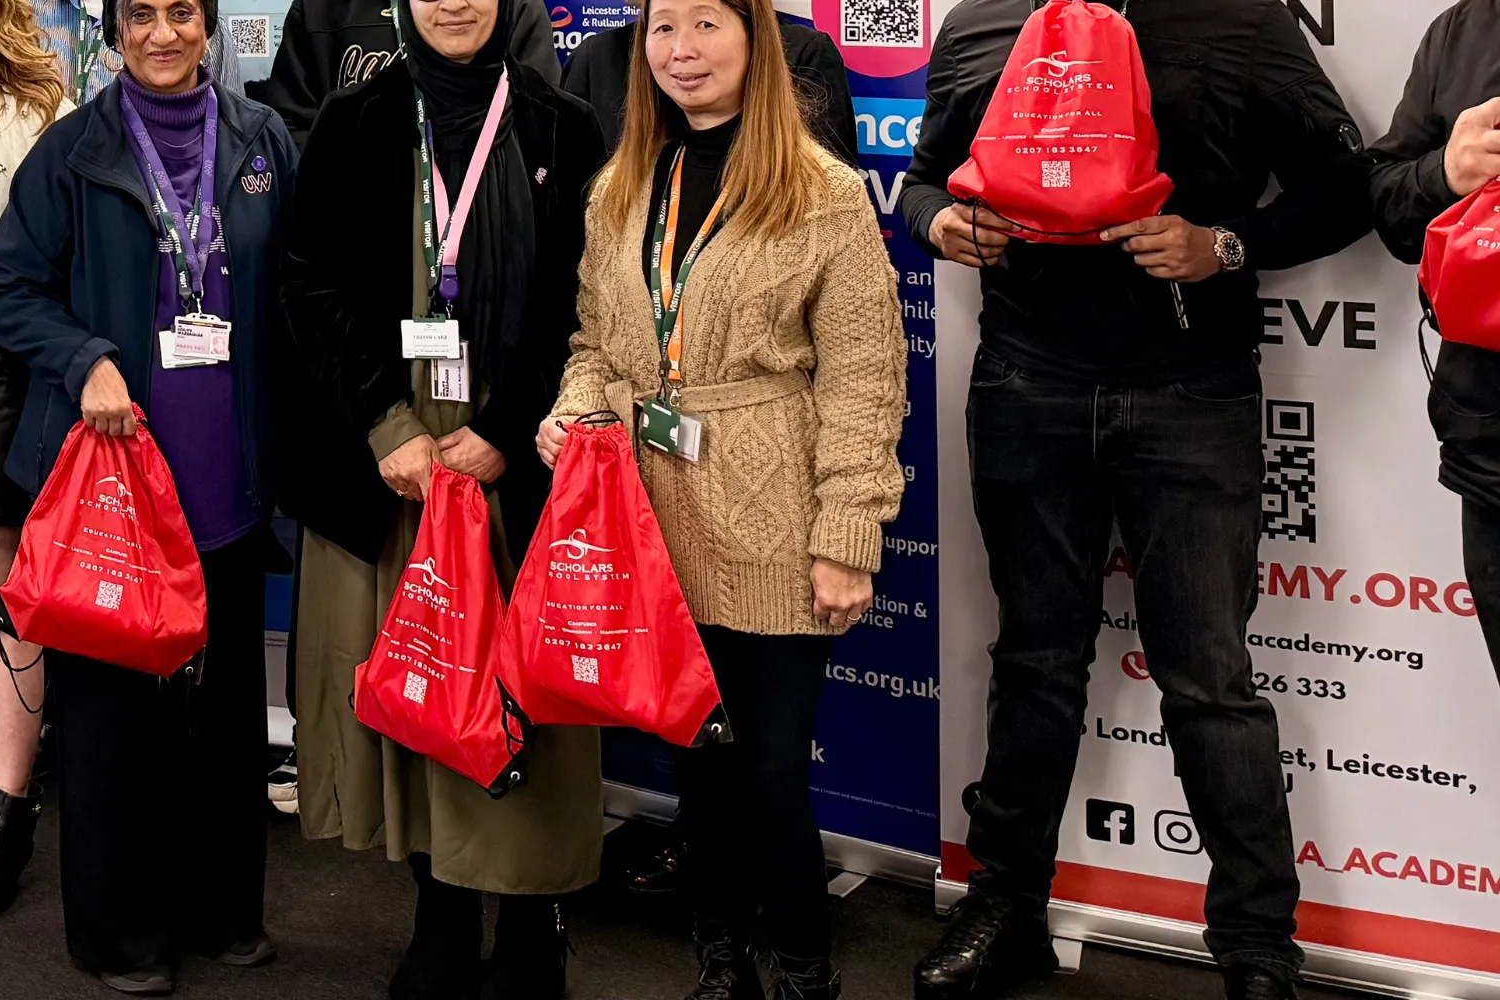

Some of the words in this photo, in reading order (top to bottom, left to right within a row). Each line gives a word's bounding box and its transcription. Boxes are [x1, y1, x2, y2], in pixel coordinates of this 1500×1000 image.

[582, 6, 621, 15] Leicester
[622, 6, 641, 15] Shir
[582, 18, 590, 27] &
[592, 18, 626, 28] Rutland
[1026, 73, 1091, 88] SCHOLARS
[241, 172, 272, 194] UW
[653, 241, 662, 268] VISITOR
[653, 289, 661, 320] VISITOR
[670, 283, 683, 312] VISITOR
[884, 534, 938, 556] uppor
[550, 561, 613, 573] SCHOLARS
[871, 595, 908, 614] tion
[914, 602, 927, 618] &
[1296, 677, 1346, 700] 333
[1326, 750, 1477, 794] Leicester,
